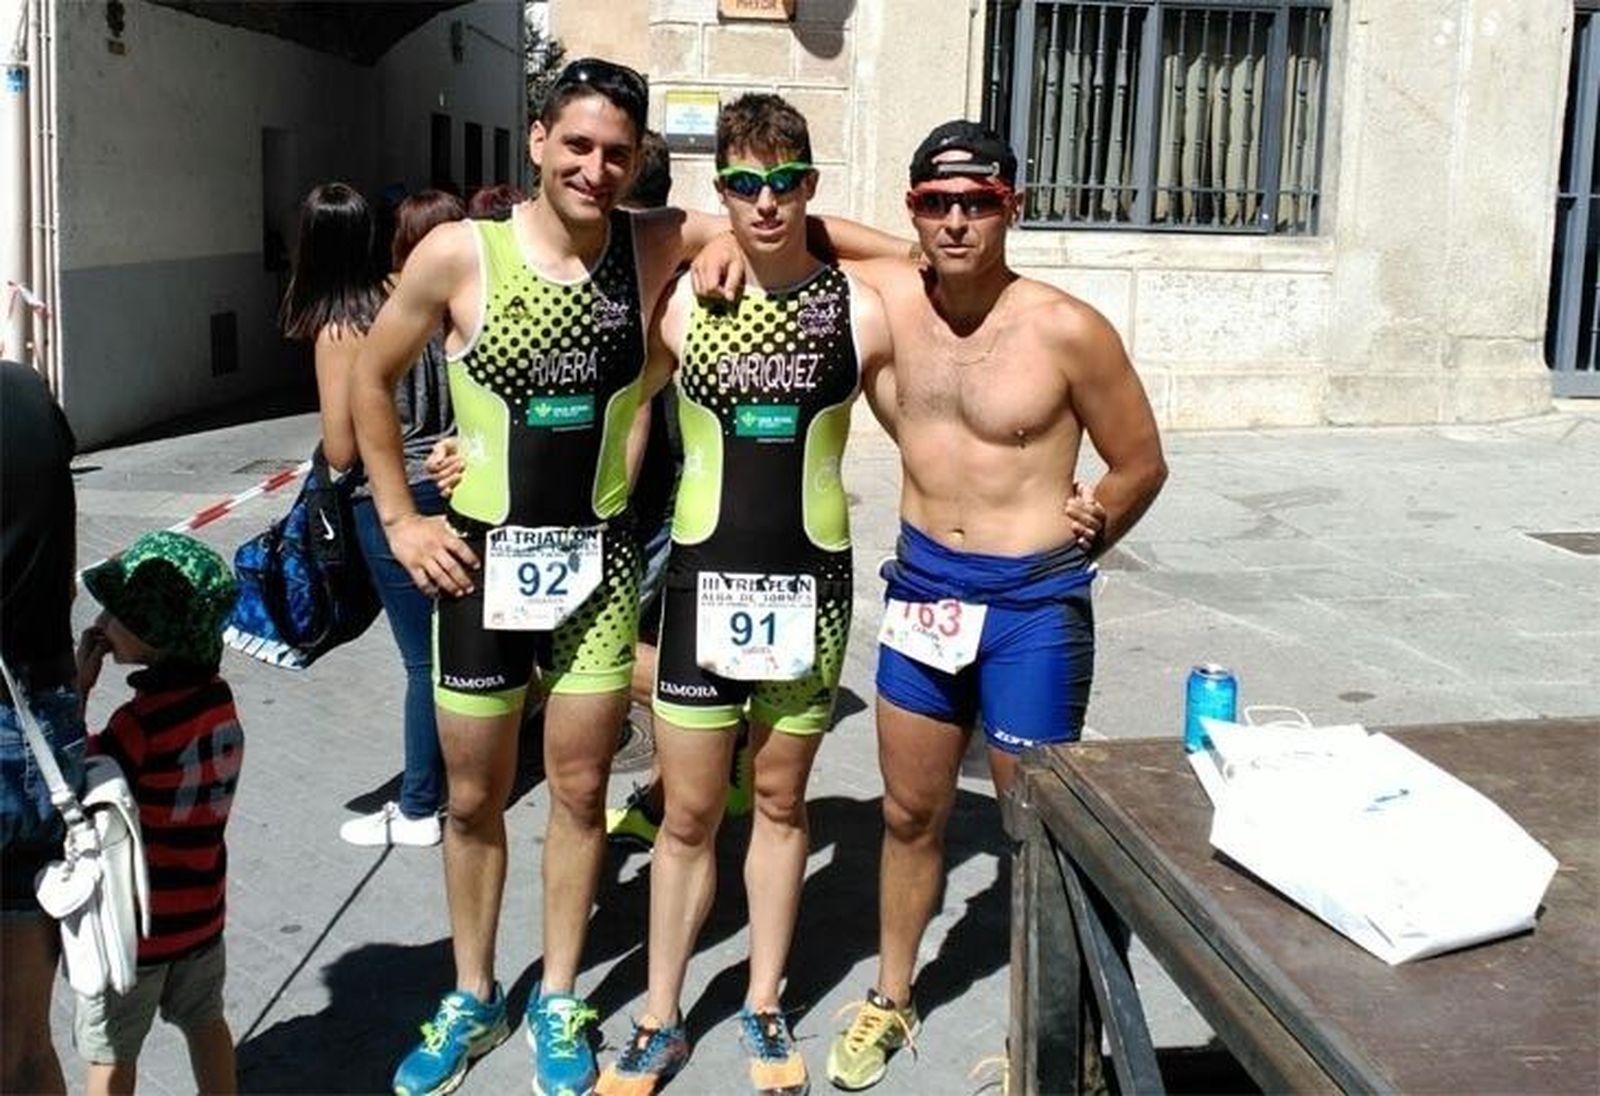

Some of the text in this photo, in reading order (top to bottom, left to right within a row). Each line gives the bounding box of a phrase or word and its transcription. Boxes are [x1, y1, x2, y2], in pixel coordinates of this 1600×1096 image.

[530, 350, 598, 386] RIVERA
[717, 353, 819, 389] ENRIQUEZ
[513, 529, 598, 544] TRIATON
[517, 562, 568, 597] 92
[730, 611, 776, 646] 91
[444, 674, 505, 689] ZAMORA
[660, 680, 719, 698] ZAMORA
